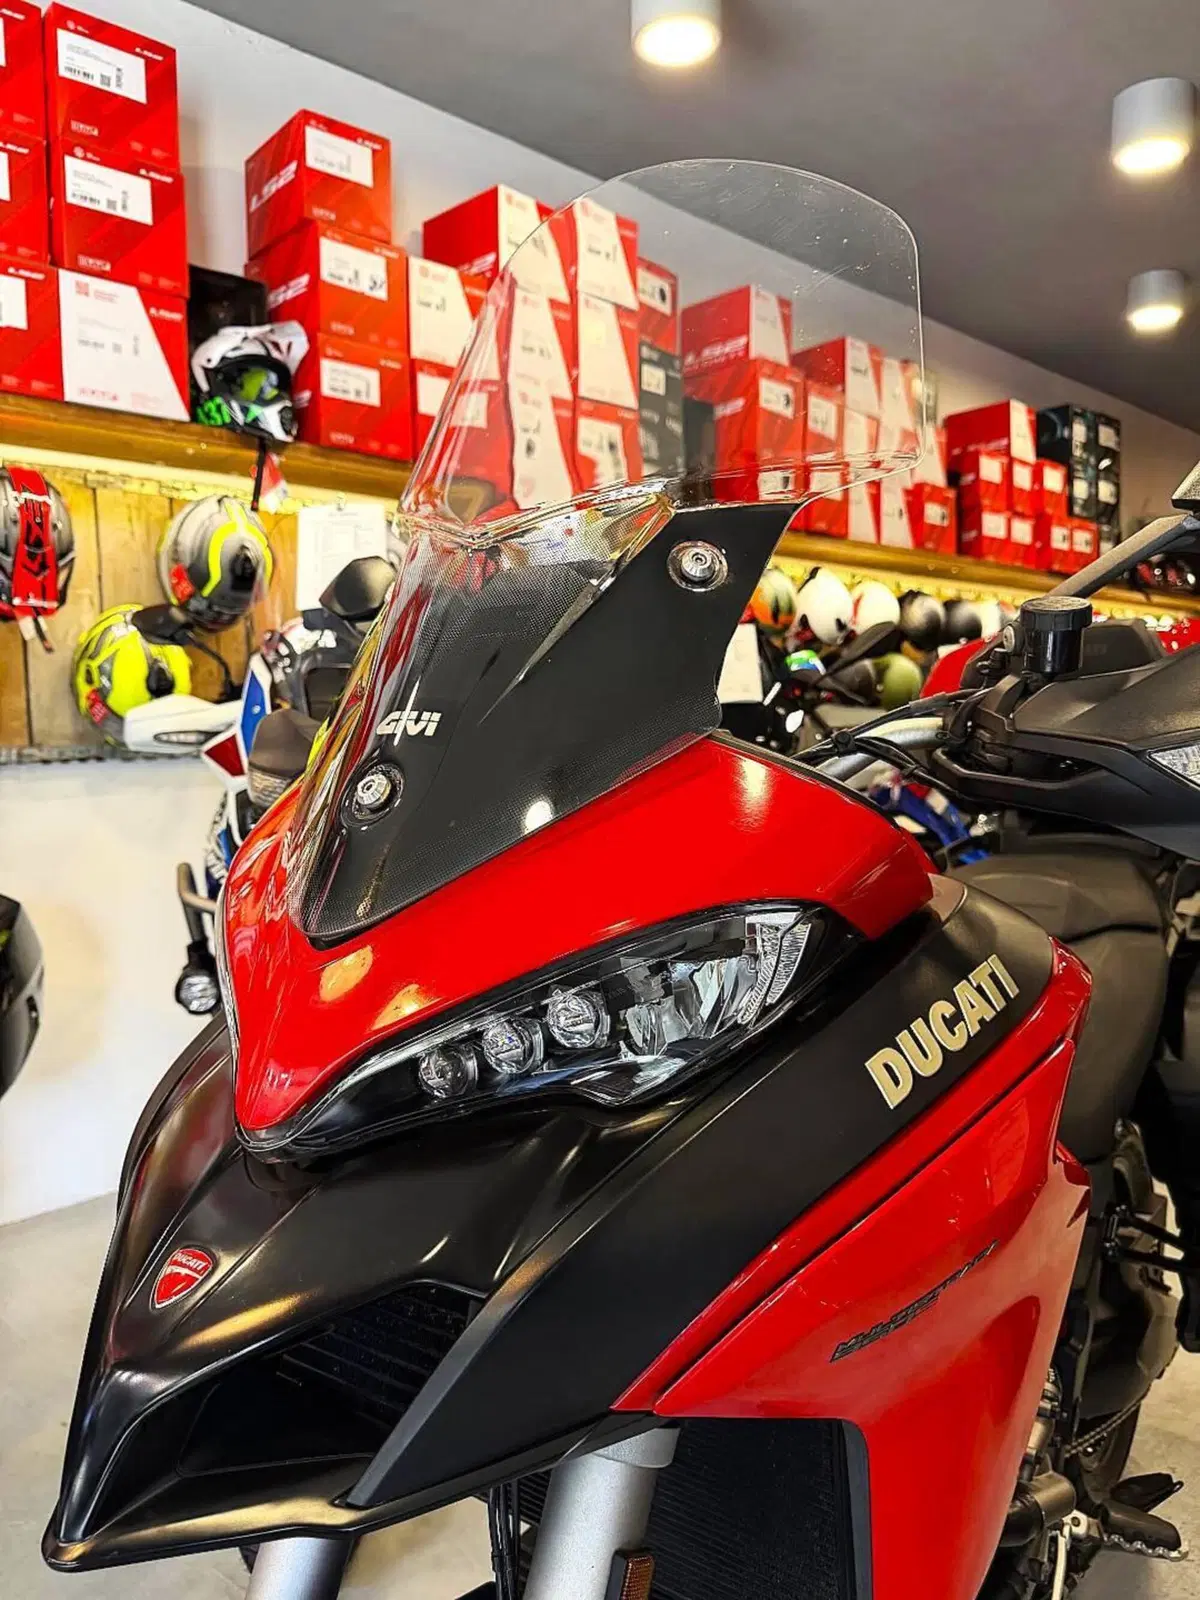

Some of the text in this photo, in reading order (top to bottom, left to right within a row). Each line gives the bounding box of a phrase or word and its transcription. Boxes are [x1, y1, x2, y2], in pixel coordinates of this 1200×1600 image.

[376, 675, 442, 747] GIVI
[864, 953, 1020, 1110] DUCATI
[172, 1252, 208, 1271] DUCATI
